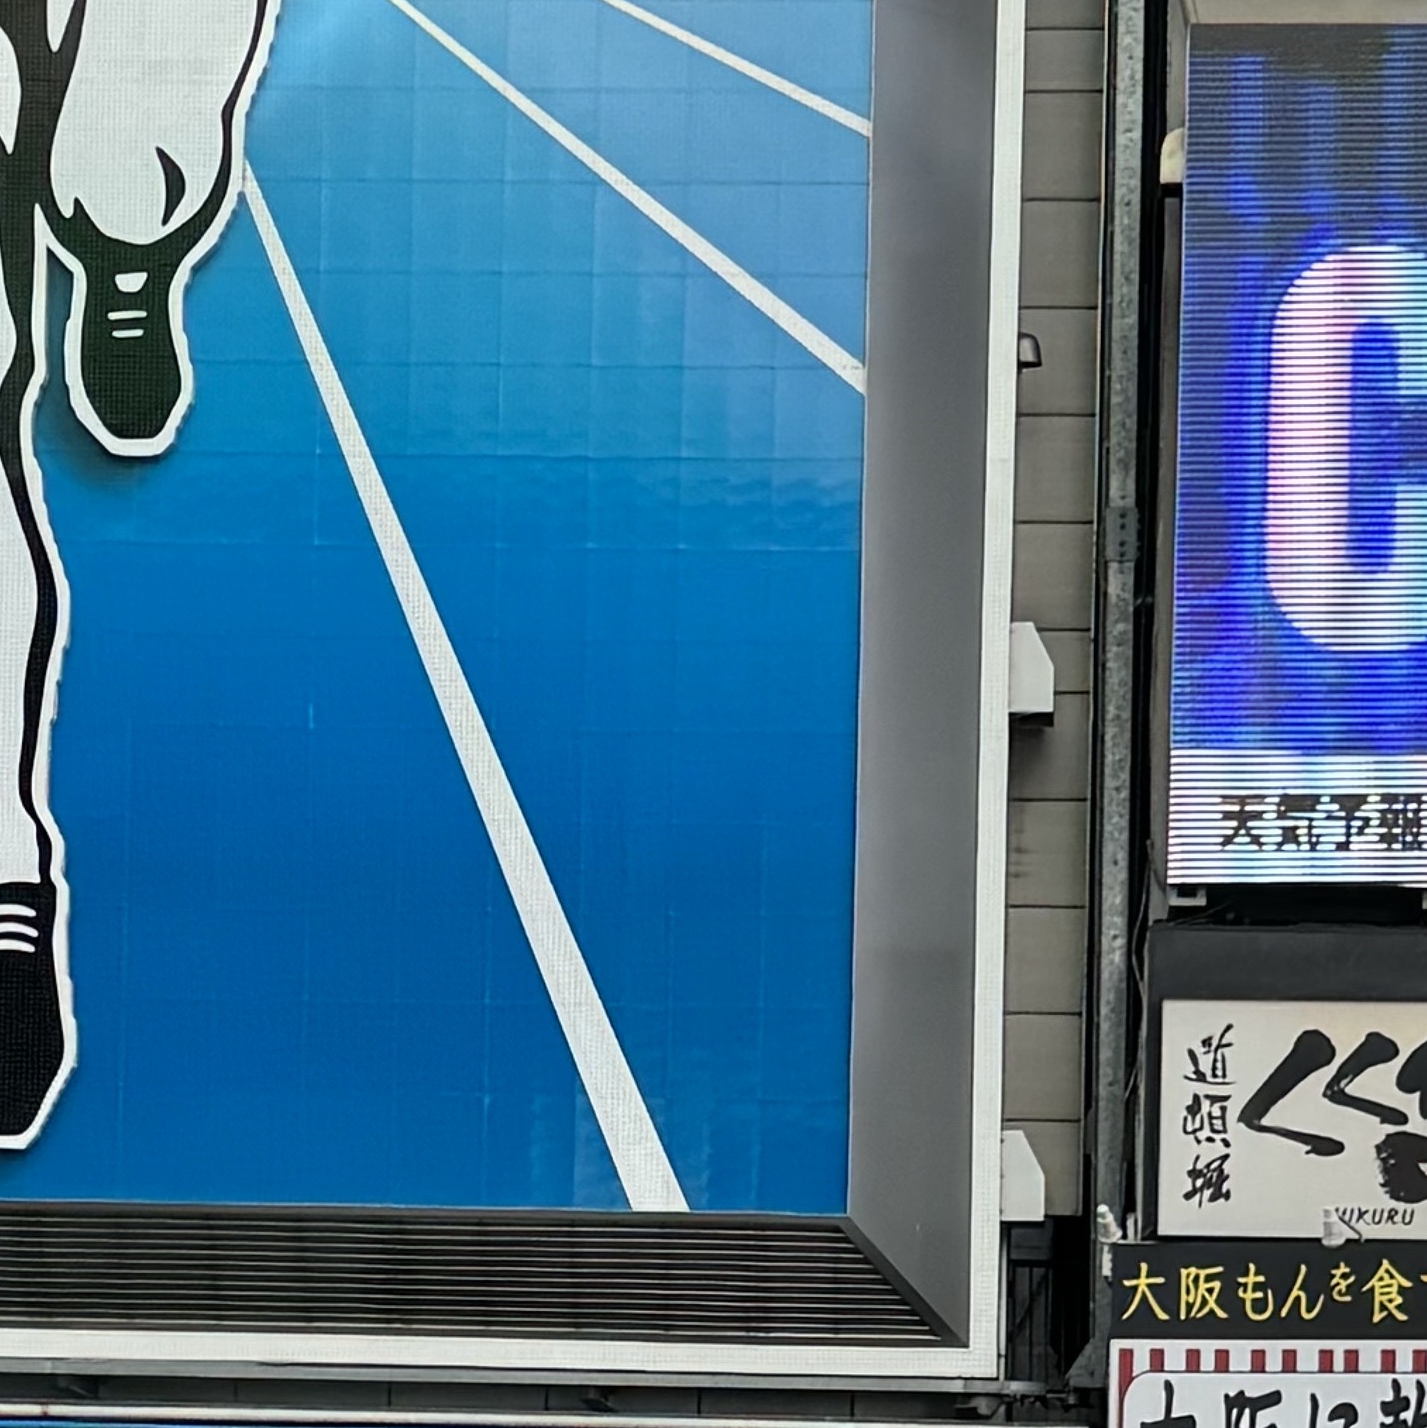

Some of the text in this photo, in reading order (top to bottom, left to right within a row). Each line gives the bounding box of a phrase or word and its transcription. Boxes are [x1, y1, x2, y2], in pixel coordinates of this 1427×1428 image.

[1220, 793, 1424, 851] 天気予報
[1182, 1022, 1236, 1209] 道頓堀
